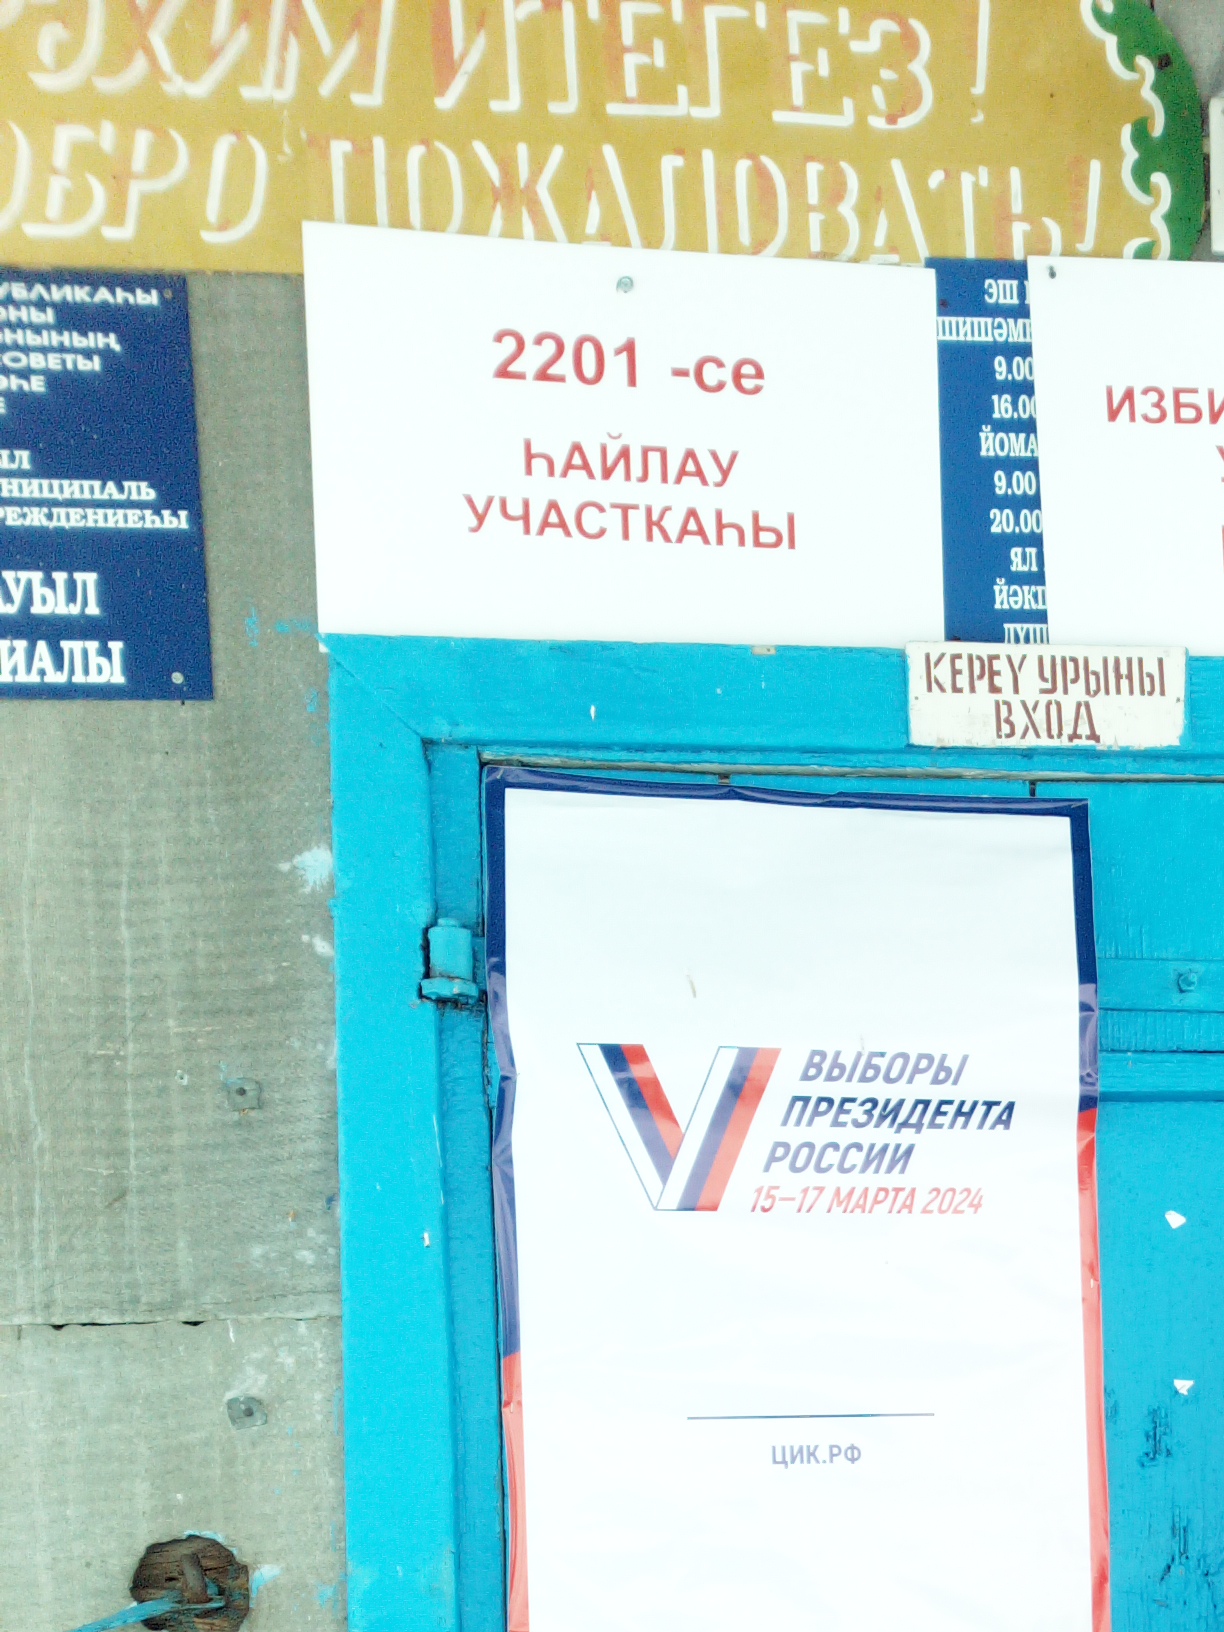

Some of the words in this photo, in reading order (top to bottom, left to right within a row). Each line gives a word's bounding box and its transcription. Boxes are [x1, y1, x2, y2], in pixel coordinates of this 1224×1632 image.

[984, 279, 1019, 304] ЭШ
[492, 328, 637, 388] 2201
[994, 355, 1034, 380] 9.00
[523, 432, 739, 488] ҺАЙЛАУ
[994, 470, 1036, 495] 9.00
[462, 493, 796, 550] УЧАСТКАҺЫ
[989, 508, 1043, 533] 20.00
[1010, 547, 1038, 571] ЯЛ
[1037, 654, 1166, 698] УРЫНЫ
[994, 699, 1101, 743] ВХОД
[799, 1049, 969, 1086] ВЫБОРЫ
[780, 1095, 1016, 1134] ПРЕЗИДЕНТА
[762, 1141, 916, 1175] РОССИИ
[828, 1186, 914, 1214] МАРТА
[920, 1187, 984, 1214] 2024
[771, 1443, 862, 1469] ЦИК.РФ
